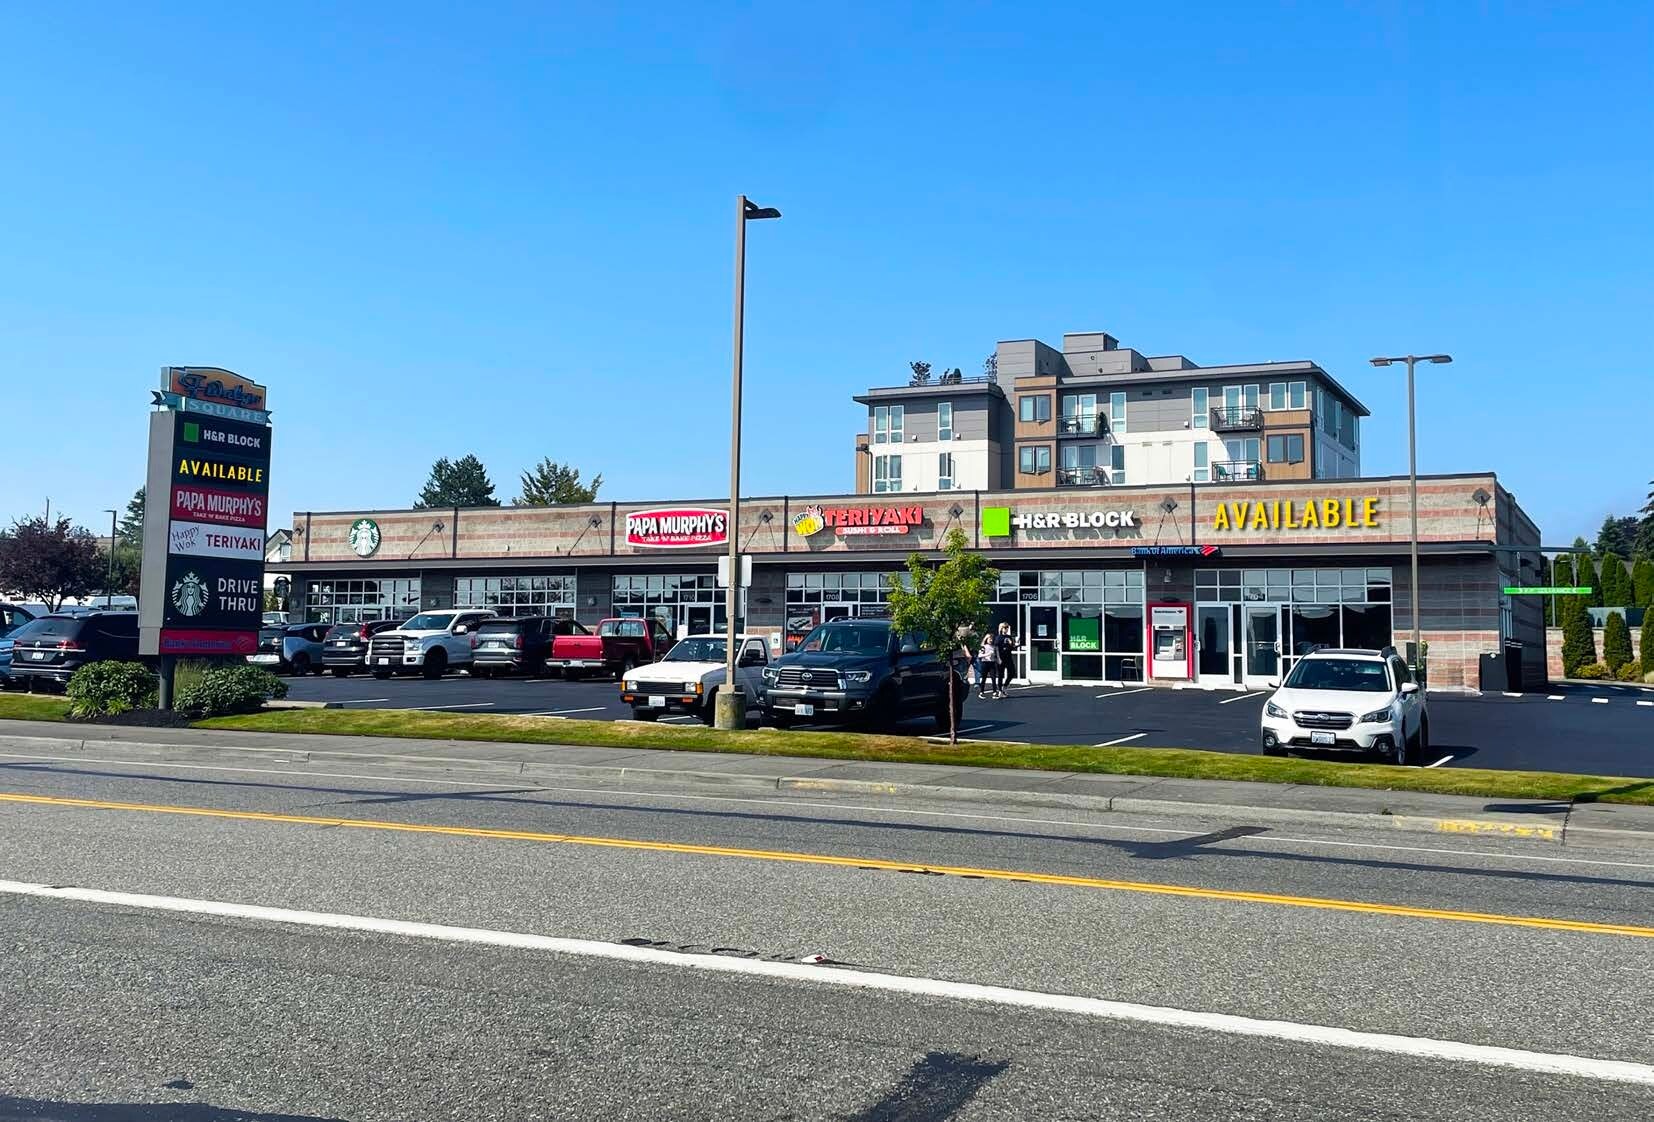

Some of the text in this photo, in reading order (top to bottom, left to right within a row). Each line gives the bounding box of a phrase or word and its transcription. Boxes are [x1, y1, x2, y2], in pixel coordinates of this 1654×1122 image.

[188, 400, 264, 422] SQUARE
[203, 429, 261, 449] H&R BLOCK
[179, 459, 263, 483] AVAILABLE
[176, 490, 262, 517] PAPA MURPHY'S
[193, 511, 207, 519] TAKE
[229, 515, 246, 523] PIZZA
[824, 506, 923, 527] TERIYAKI
[1019, 510, 1135, 530] H&R BLOCK
[1213, 497, 1379, 530] AVAILABLE
[170, 525, 200, 543] Happy
[626, 512, 725, 537] PAPA MURPHY'S
[878, 526, 900, 534] ROLL
[174, 539, 197, 553] Wok
[205, 534, 261, 551] TERIYAKI
[217, 577, 259, 595] DRIVE
[218, 596, 257, 612] THRU
[1069, 641, 1098, 650] BLOCK
